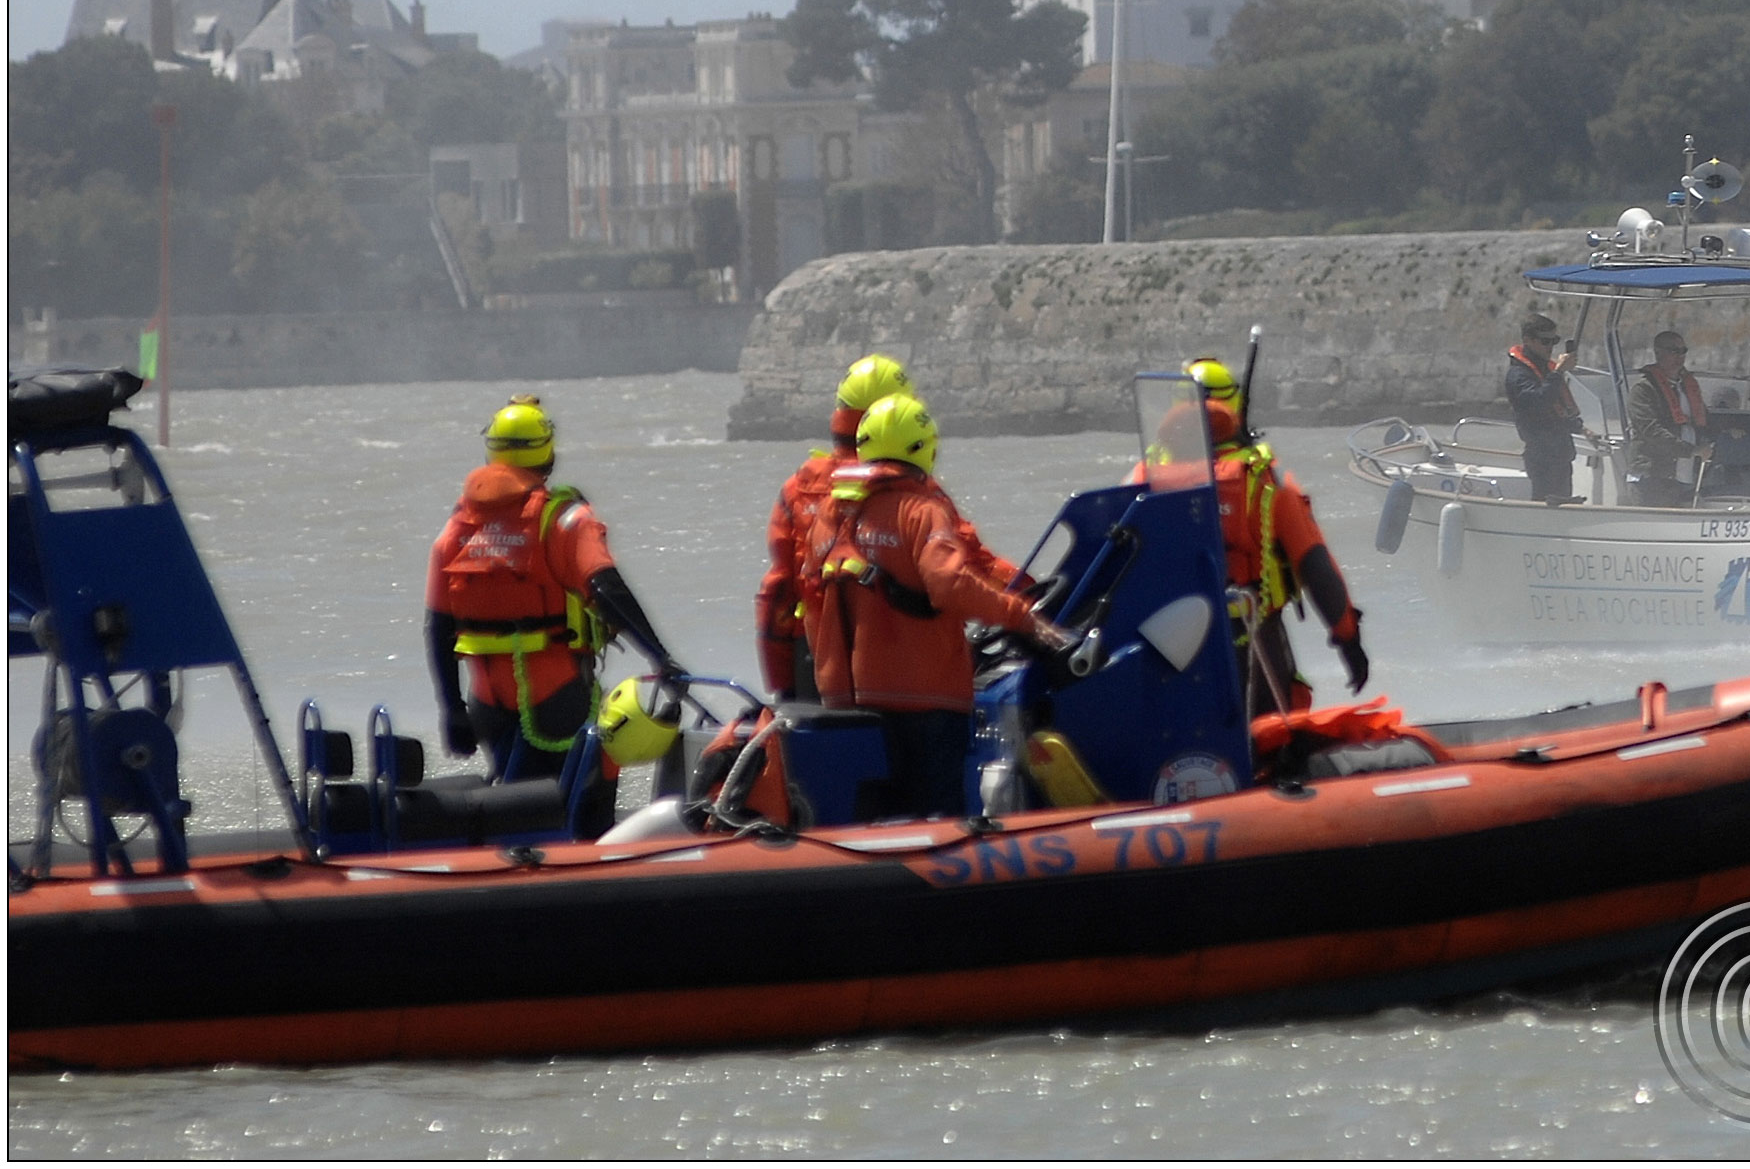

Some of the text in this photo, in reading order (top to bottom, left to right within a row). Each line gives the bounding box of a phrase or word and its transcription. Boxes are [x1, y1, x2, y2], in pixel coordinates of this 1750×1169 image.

[1700, 520, 1718, 538] LR
[1522, 551, 1704, 583] PORT DE PLAISANCE
[1529, 595, 1704, 626] DE LA ROCHELLE
[929, 820, 1222, 883] SNS 707
